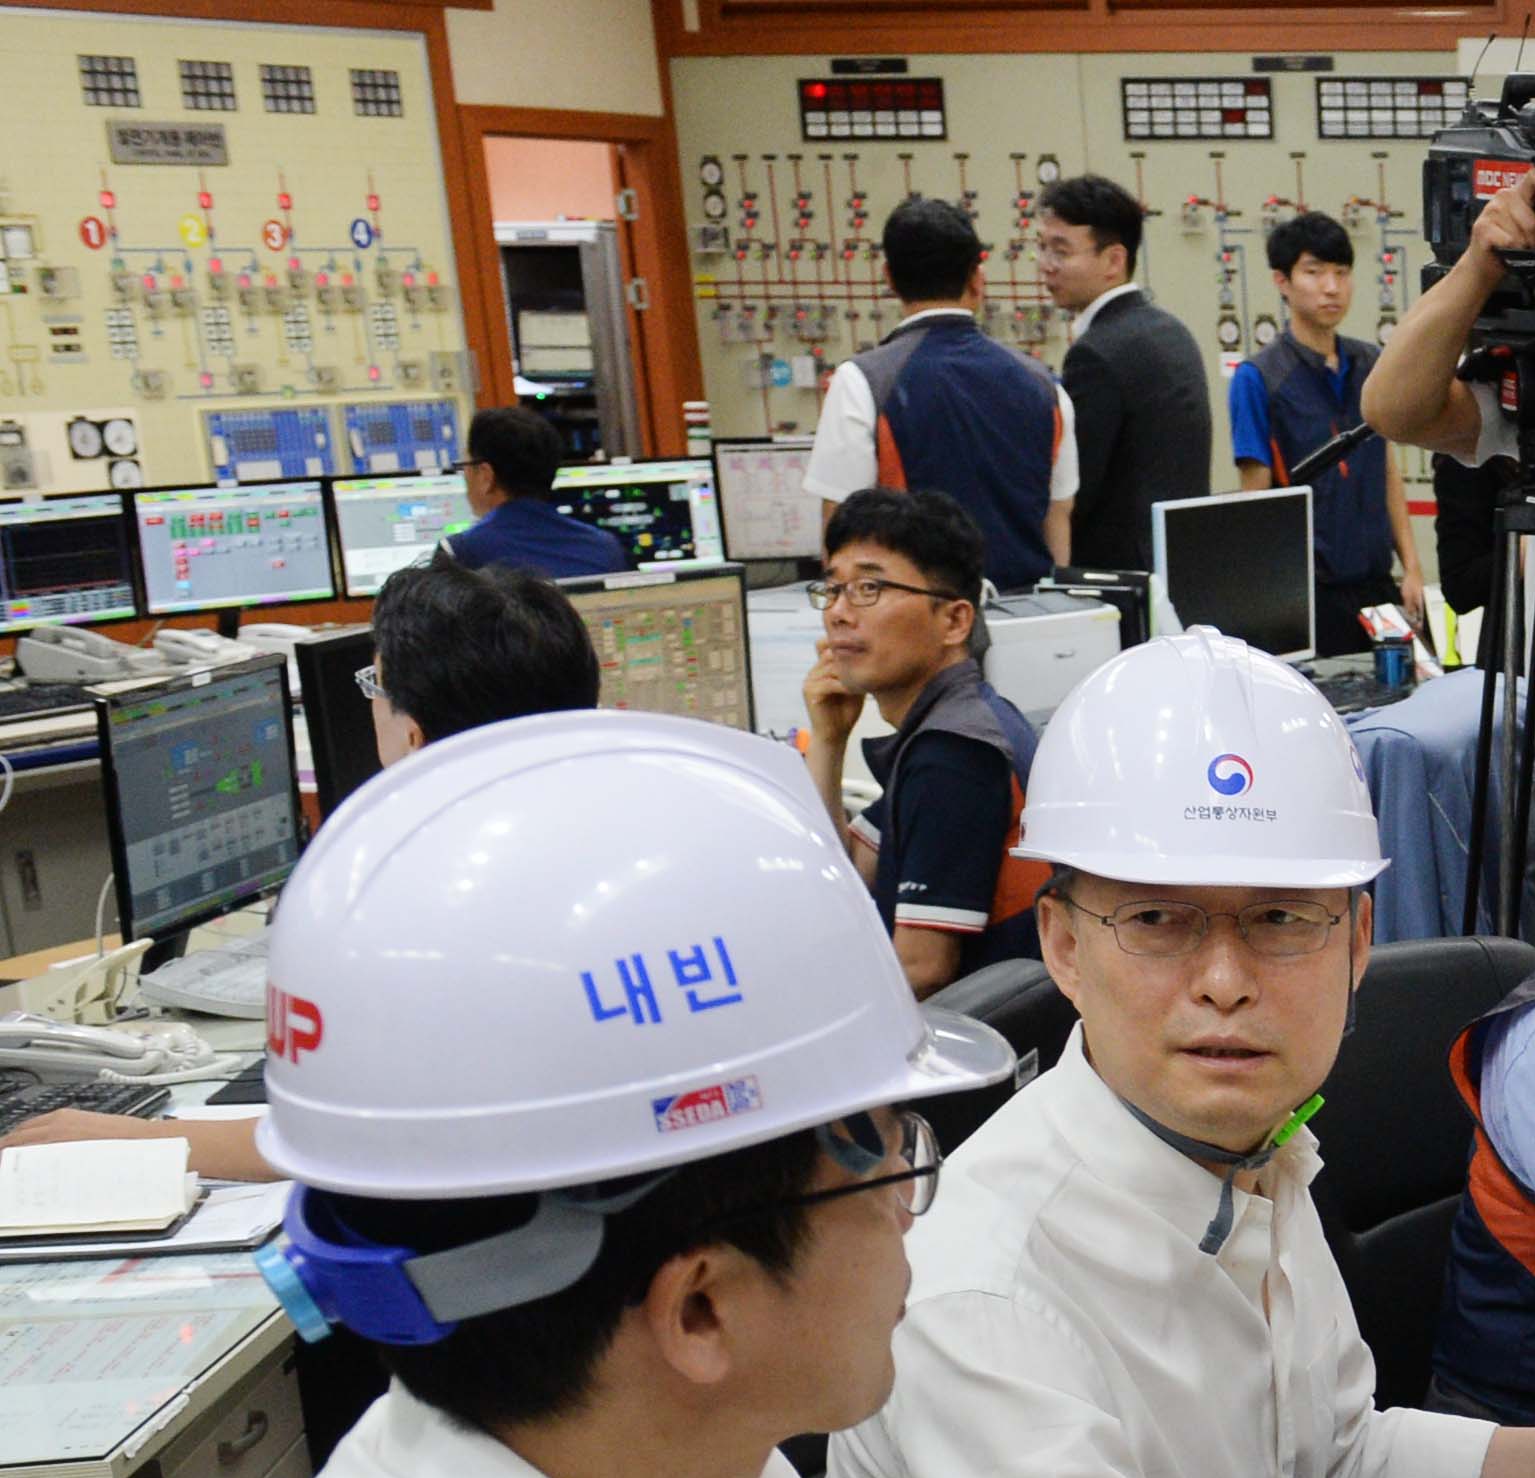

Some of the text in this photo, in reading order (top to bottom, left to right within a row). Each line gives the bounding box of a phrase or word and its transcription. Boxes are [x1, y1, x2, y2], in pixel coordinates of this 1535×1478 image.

[86, 218, 99, 247] 1
[186, 218, 202, 244] 2
[267, 222, 284, 250] 3
[353, 222, 371, 246] 4
[1183, 805, 1278, 822] 산업통상자원부
[580, 936, 742, 1025] 내빈
